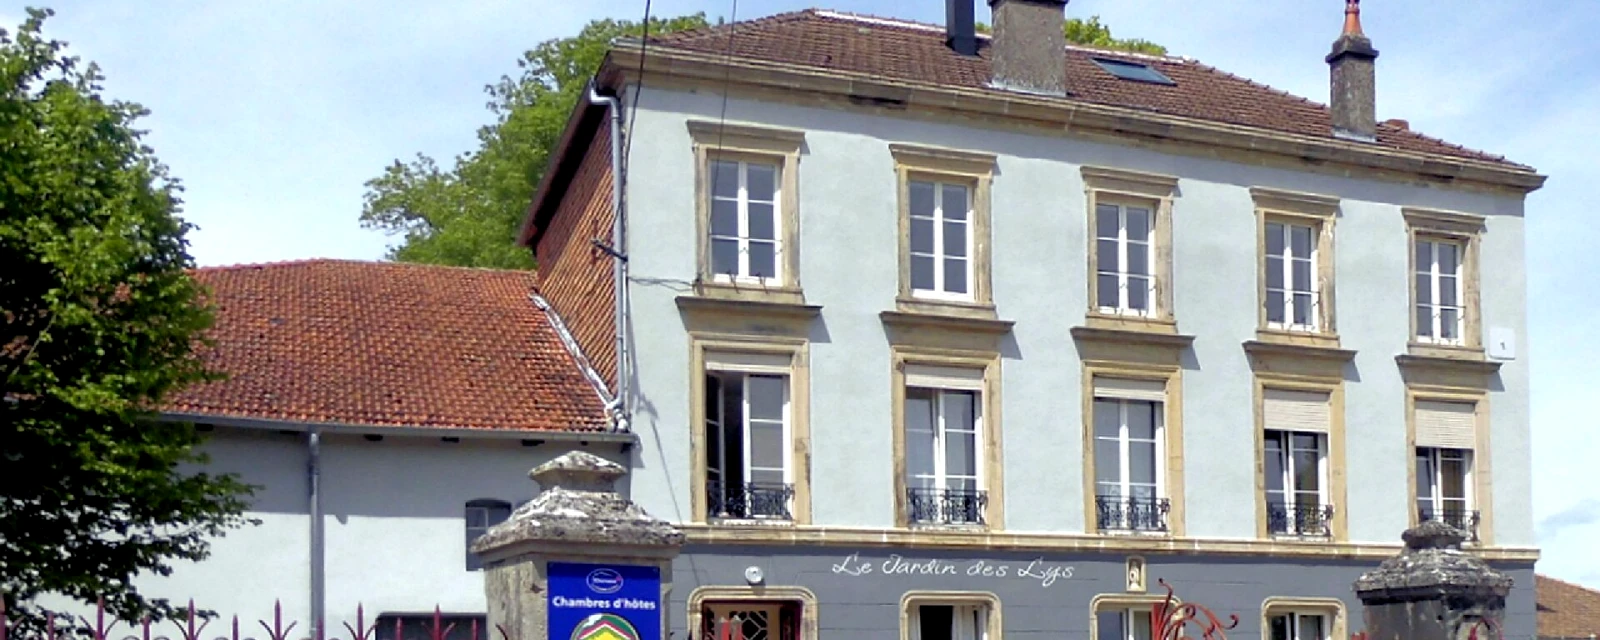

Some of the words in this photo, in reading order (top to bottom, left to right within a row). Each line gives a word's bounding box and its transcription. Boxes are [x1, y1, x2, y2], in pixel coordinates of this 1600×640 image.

[832, 551, 872, 577] Le
[881, 554, 957, 575] Jardin
[966, 559, 1009, 577] des
[1017, 556, 1075, 587] Lys
[552, 596, 611, 608] Chambres
[613, 597, 656, 610] d'hôtes
